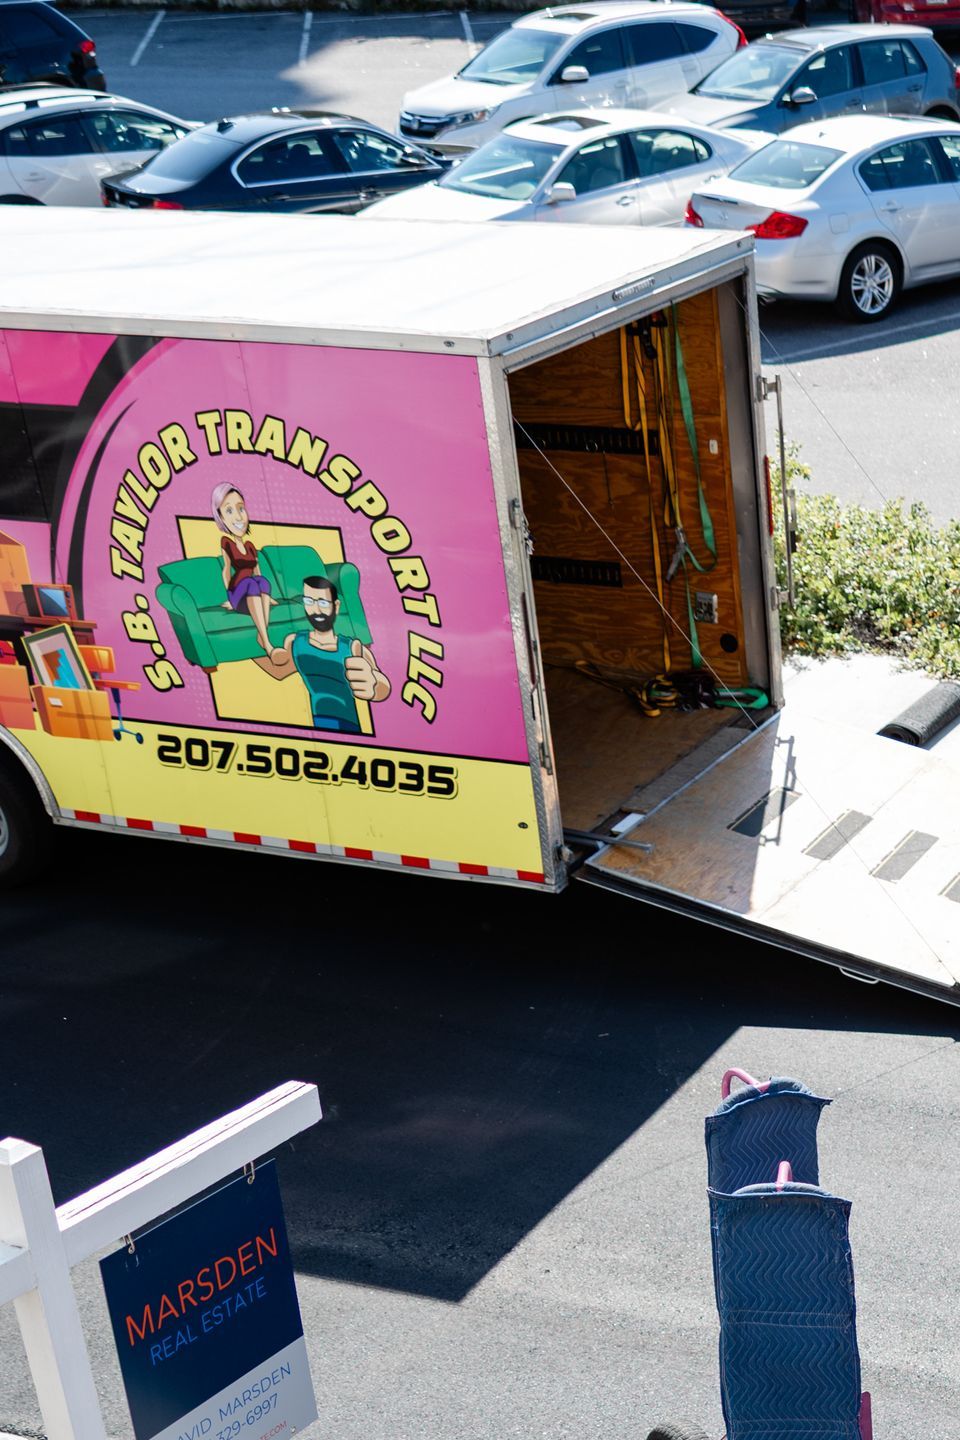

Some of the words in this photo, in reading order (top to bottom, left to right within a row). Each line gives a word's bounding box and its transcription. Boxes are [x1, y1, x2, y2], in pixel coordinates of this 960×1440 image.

[109, 422, 198, 583] TAYLOR
[195, 409, 442, 628] TRANSPORT
[122, 593, 185, 692] S.B.
[401, 630, 444, 724] LLC
[157, 734, 458, 798] 207.502.4035
[125, 1227, 278, 1347] MARSDEN
[150, 1323, 198, 1366] REAL
[201, 1276, 267, 1333] ESTATE
[219, 1361, 292, 1422] MARSDEN
